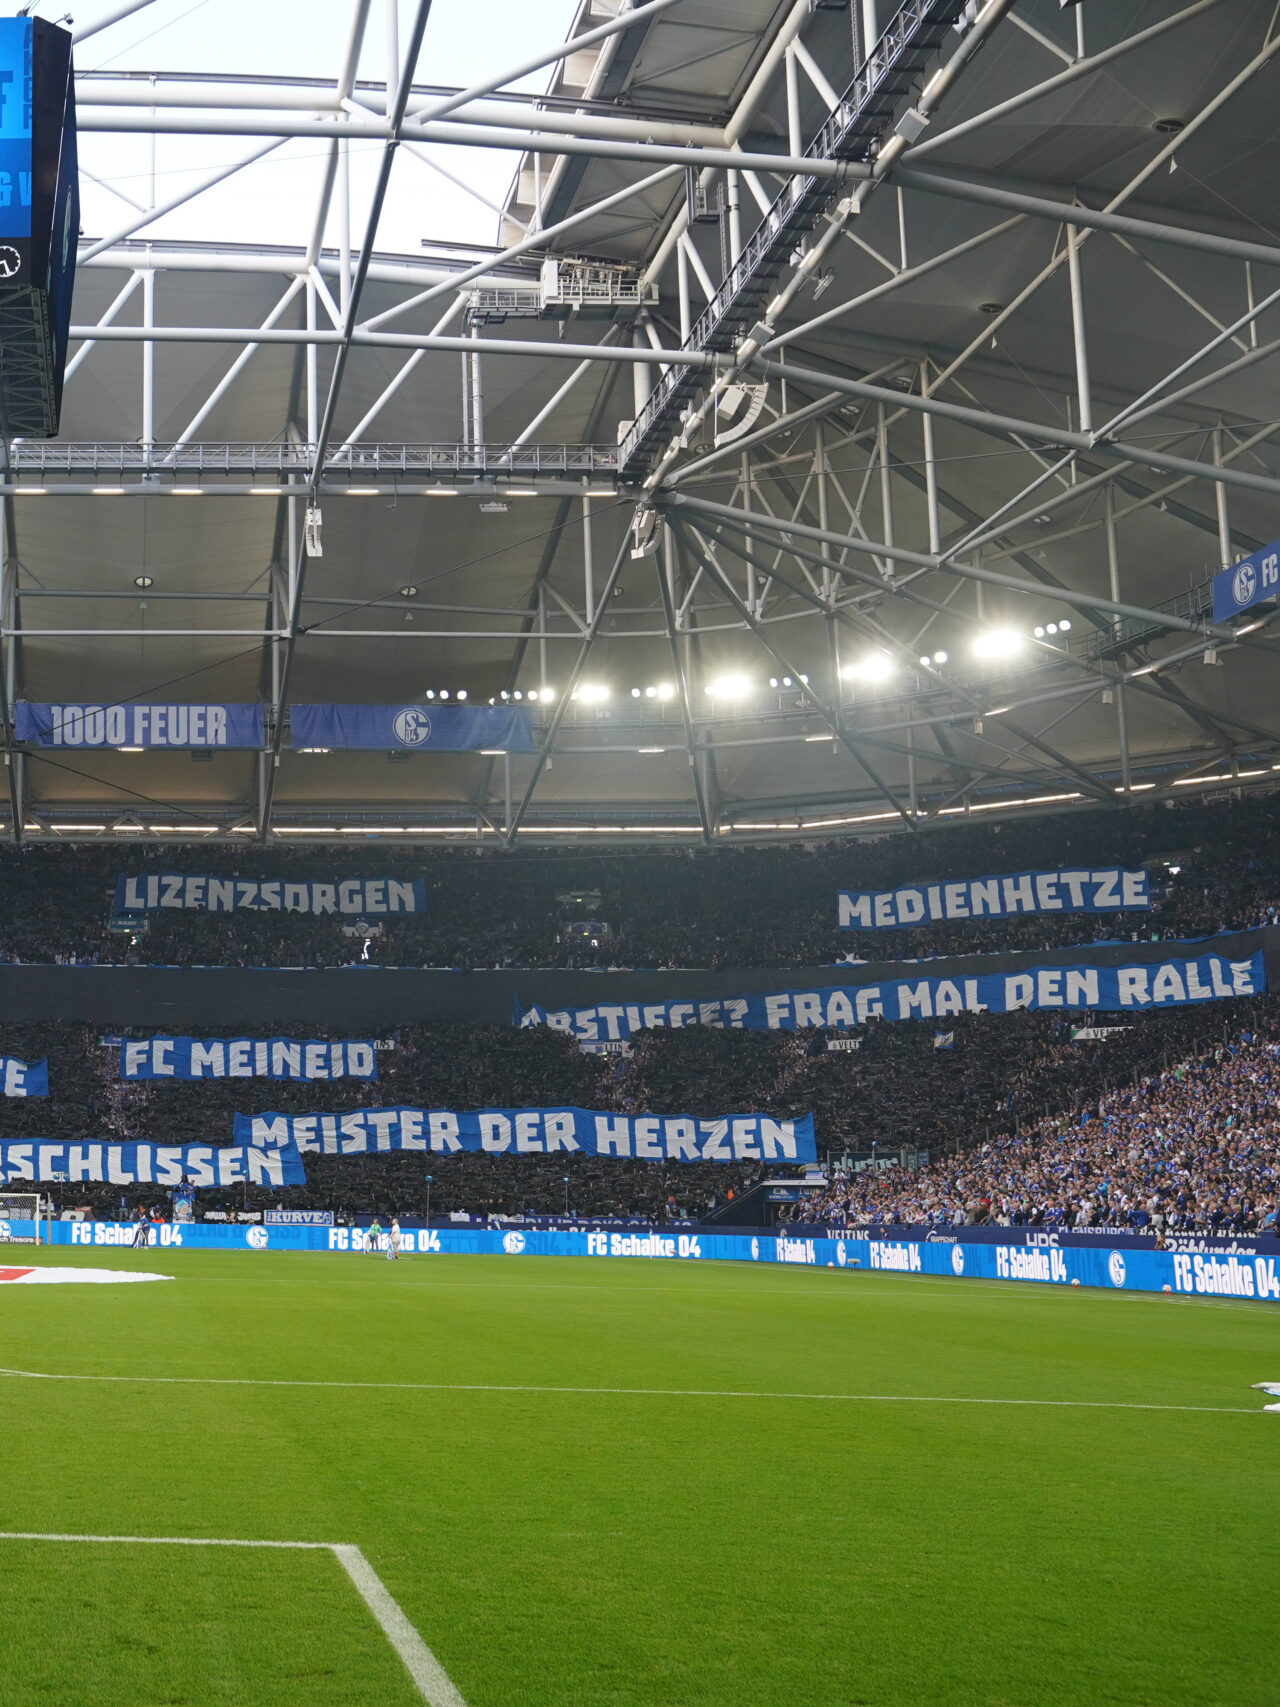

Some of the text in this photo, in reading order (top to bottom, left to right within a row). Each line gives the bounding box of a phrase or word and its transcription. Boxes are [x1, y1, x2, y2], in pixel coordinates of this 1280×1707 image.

[1262, 553, 1278, 588] FC
[51, 706, 227, 745] 1000 FEUER
[124, 875, 416, 915] LIZENZSORGEN
[838, 870, 1148, 928] MEDIENHETZE
[765, 986, 883, 1030] FRAG
[898, 979, 988, 1020] MAL
[1004, 968, 1099, 1011] DEN
[1117, 958, 1255, 1006] RALLE
[125, 1040, 374, 1078] FC MEINEID
[251, 1111, 797, 1160] MEISTER DER HERZEN
[72, 1222, 182, 1246] FC Schae 04
[270, 1212, 322, 1223] KURVE
[328, 1228, 348, 1250] FC
[418, 1230, 440, 1252] 04
[587, 1233, 701, 1258] FC Schalke 04
[776, 1238, 815, 1263] FC Schalke 04
[870, 1242, 920, 1271] FC Schalke 04
[996, 1247, 1067, 1282] FC Schalke 04
[1174, 1254, 1280, 1299] FC Schalke 04
